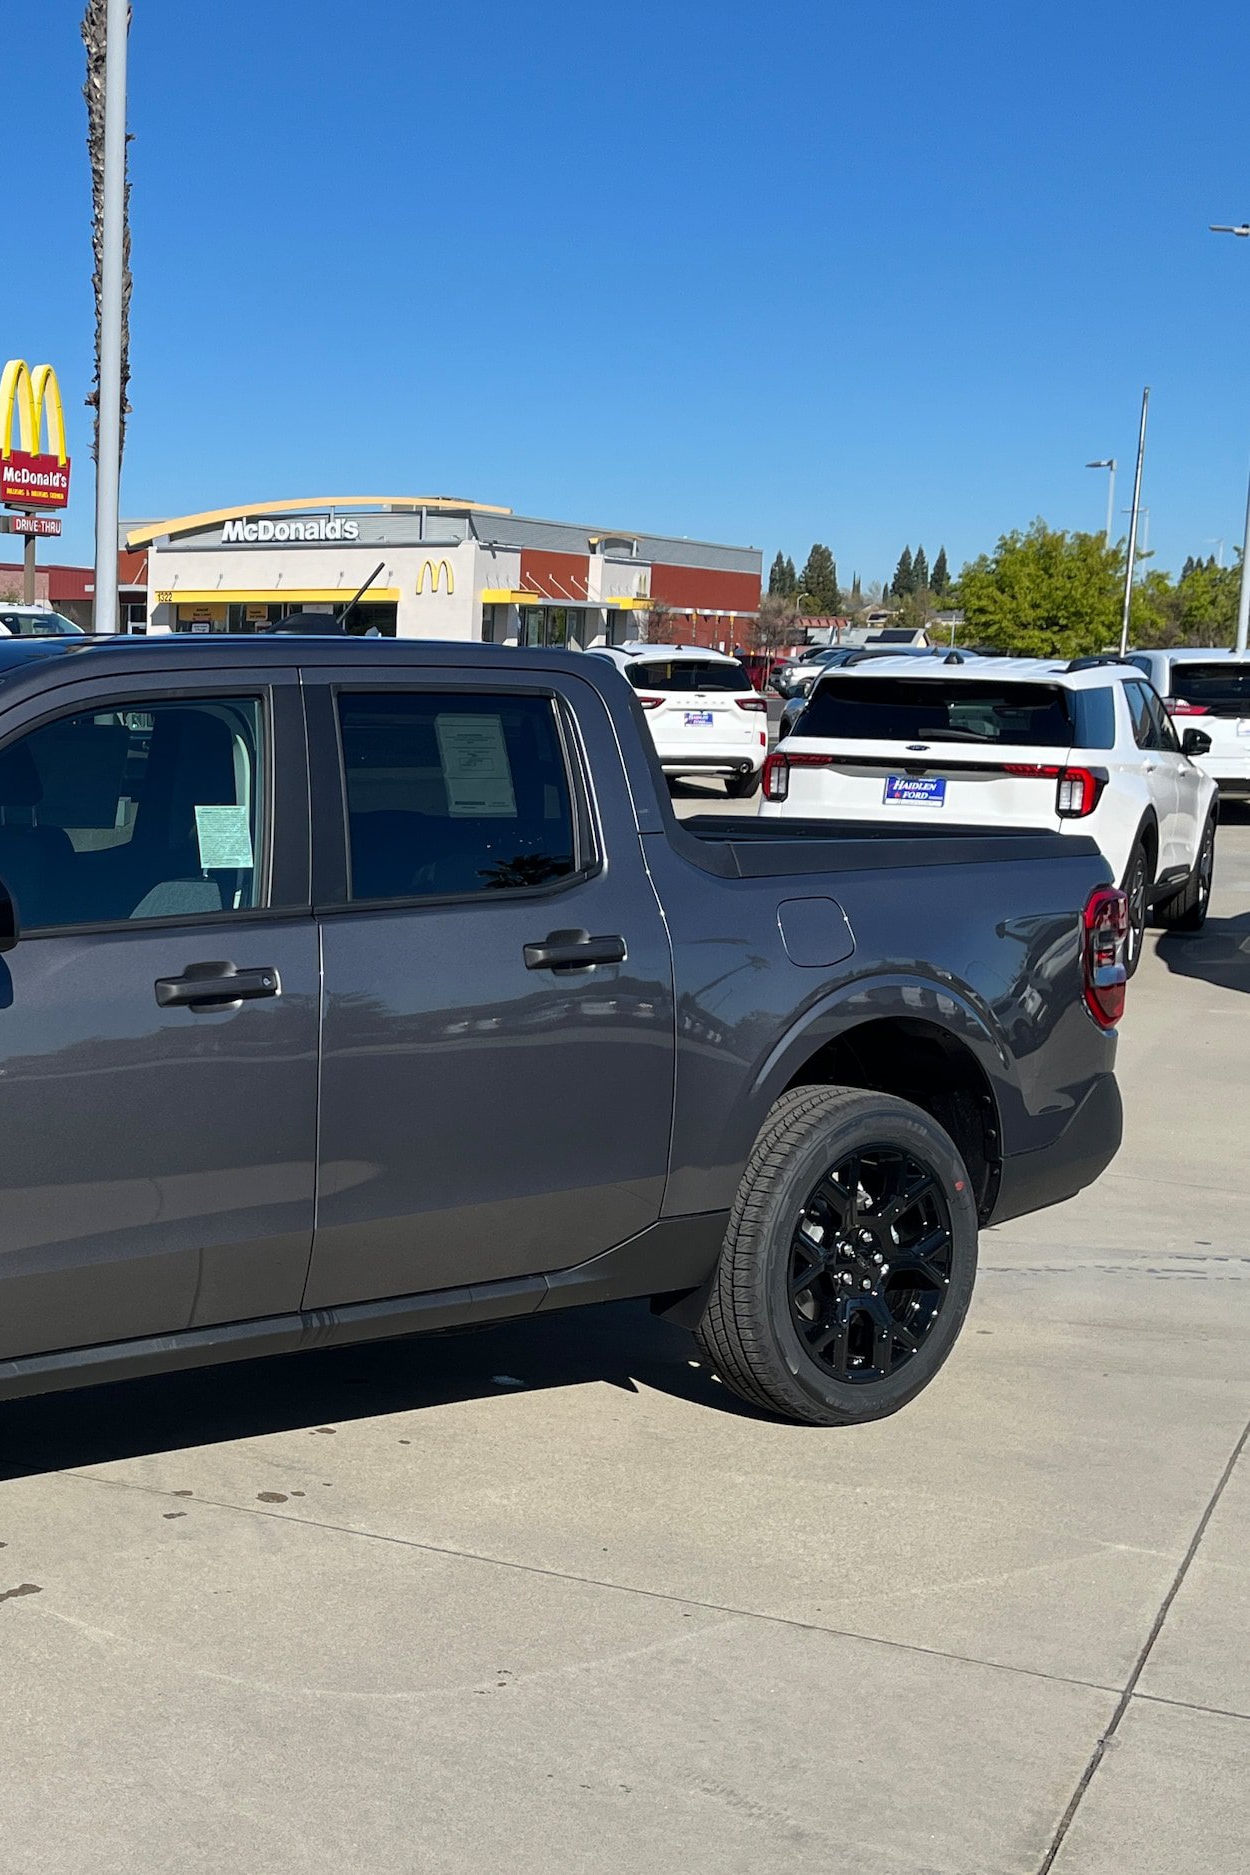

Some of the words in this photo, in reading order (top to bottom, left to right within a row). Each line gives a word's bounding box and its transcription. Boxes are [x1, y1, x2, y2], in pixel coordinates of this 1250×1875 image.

[3, 466, 67, 488] McDonald's
[15, 518, 61, 534] DRIVE-THRU
[221, 518, 359, 541] McDonald's
[157, 591, 172, 602] 1322
[893, 779, 937, 791] HAIDLEN
[903, 790, 929, 799] FORD
